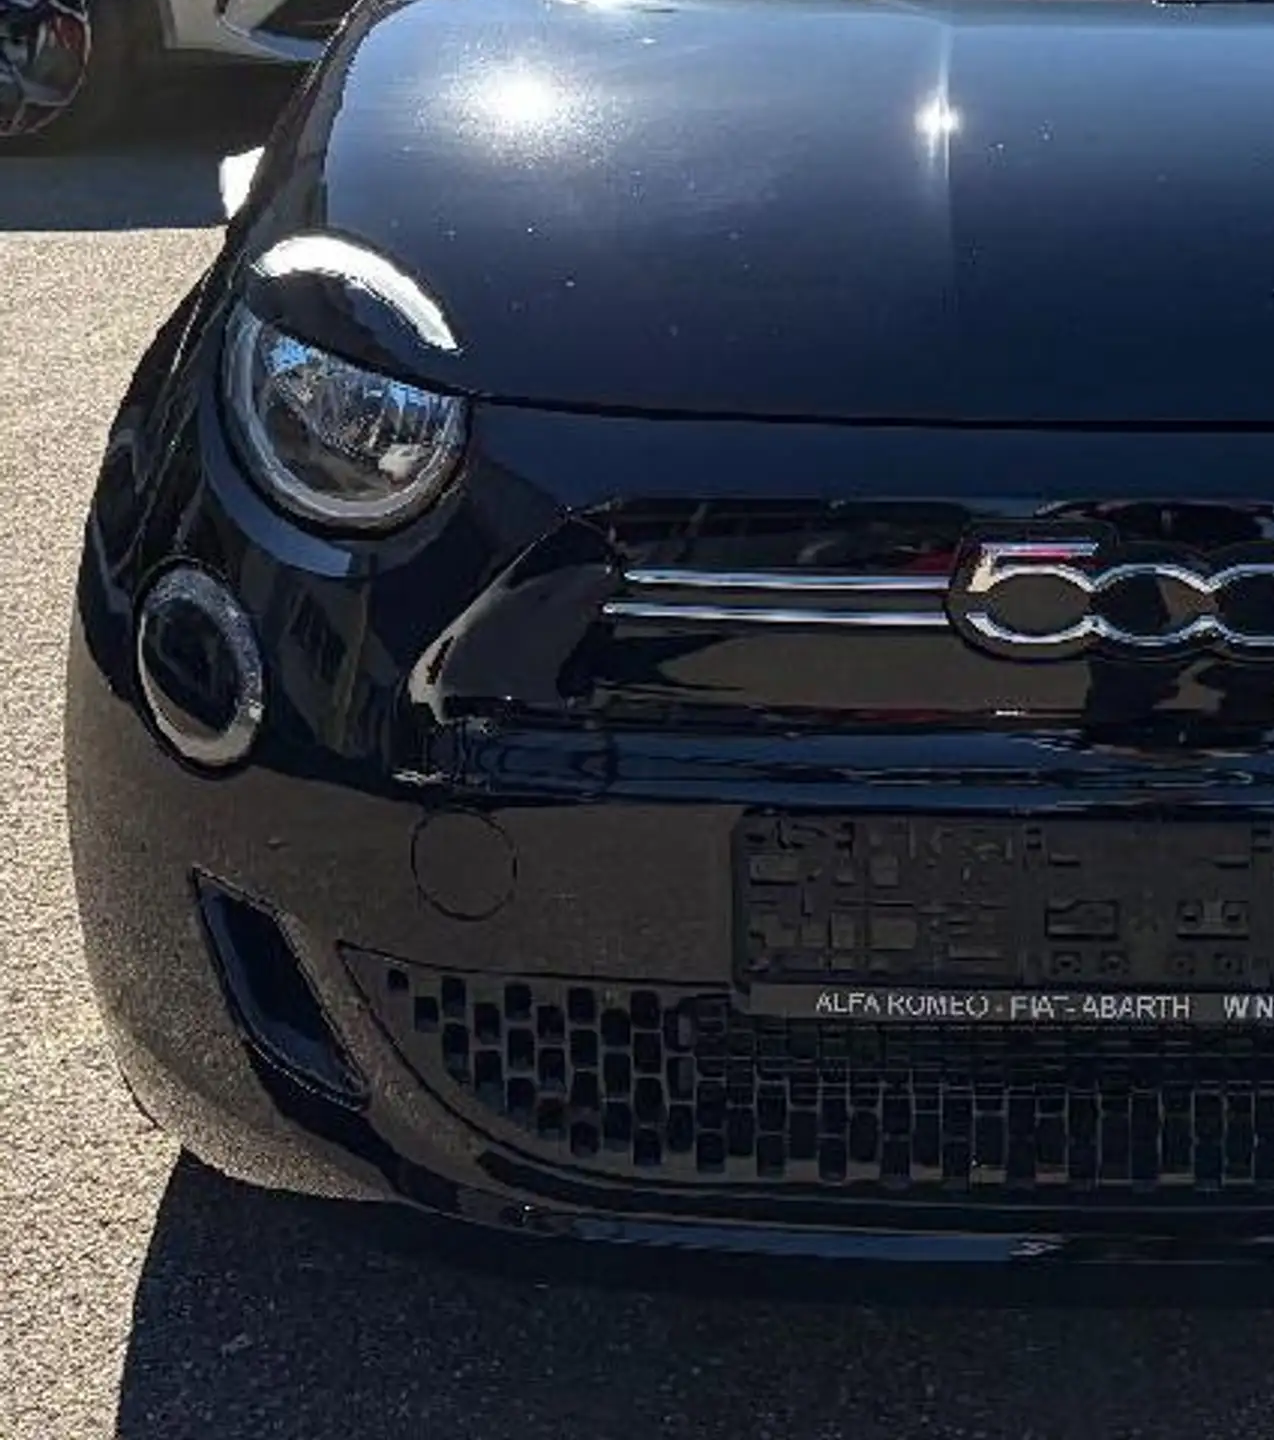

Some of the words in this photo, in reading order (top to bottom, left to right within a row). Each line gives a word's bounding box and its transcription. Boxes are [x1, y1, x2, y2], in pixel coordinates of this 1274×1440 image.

[816, 992, 881, 1015] ALFA
[888, 994, 989, 1018] ROMEO
[1082, 995, 1190, 1019] ABARTH
